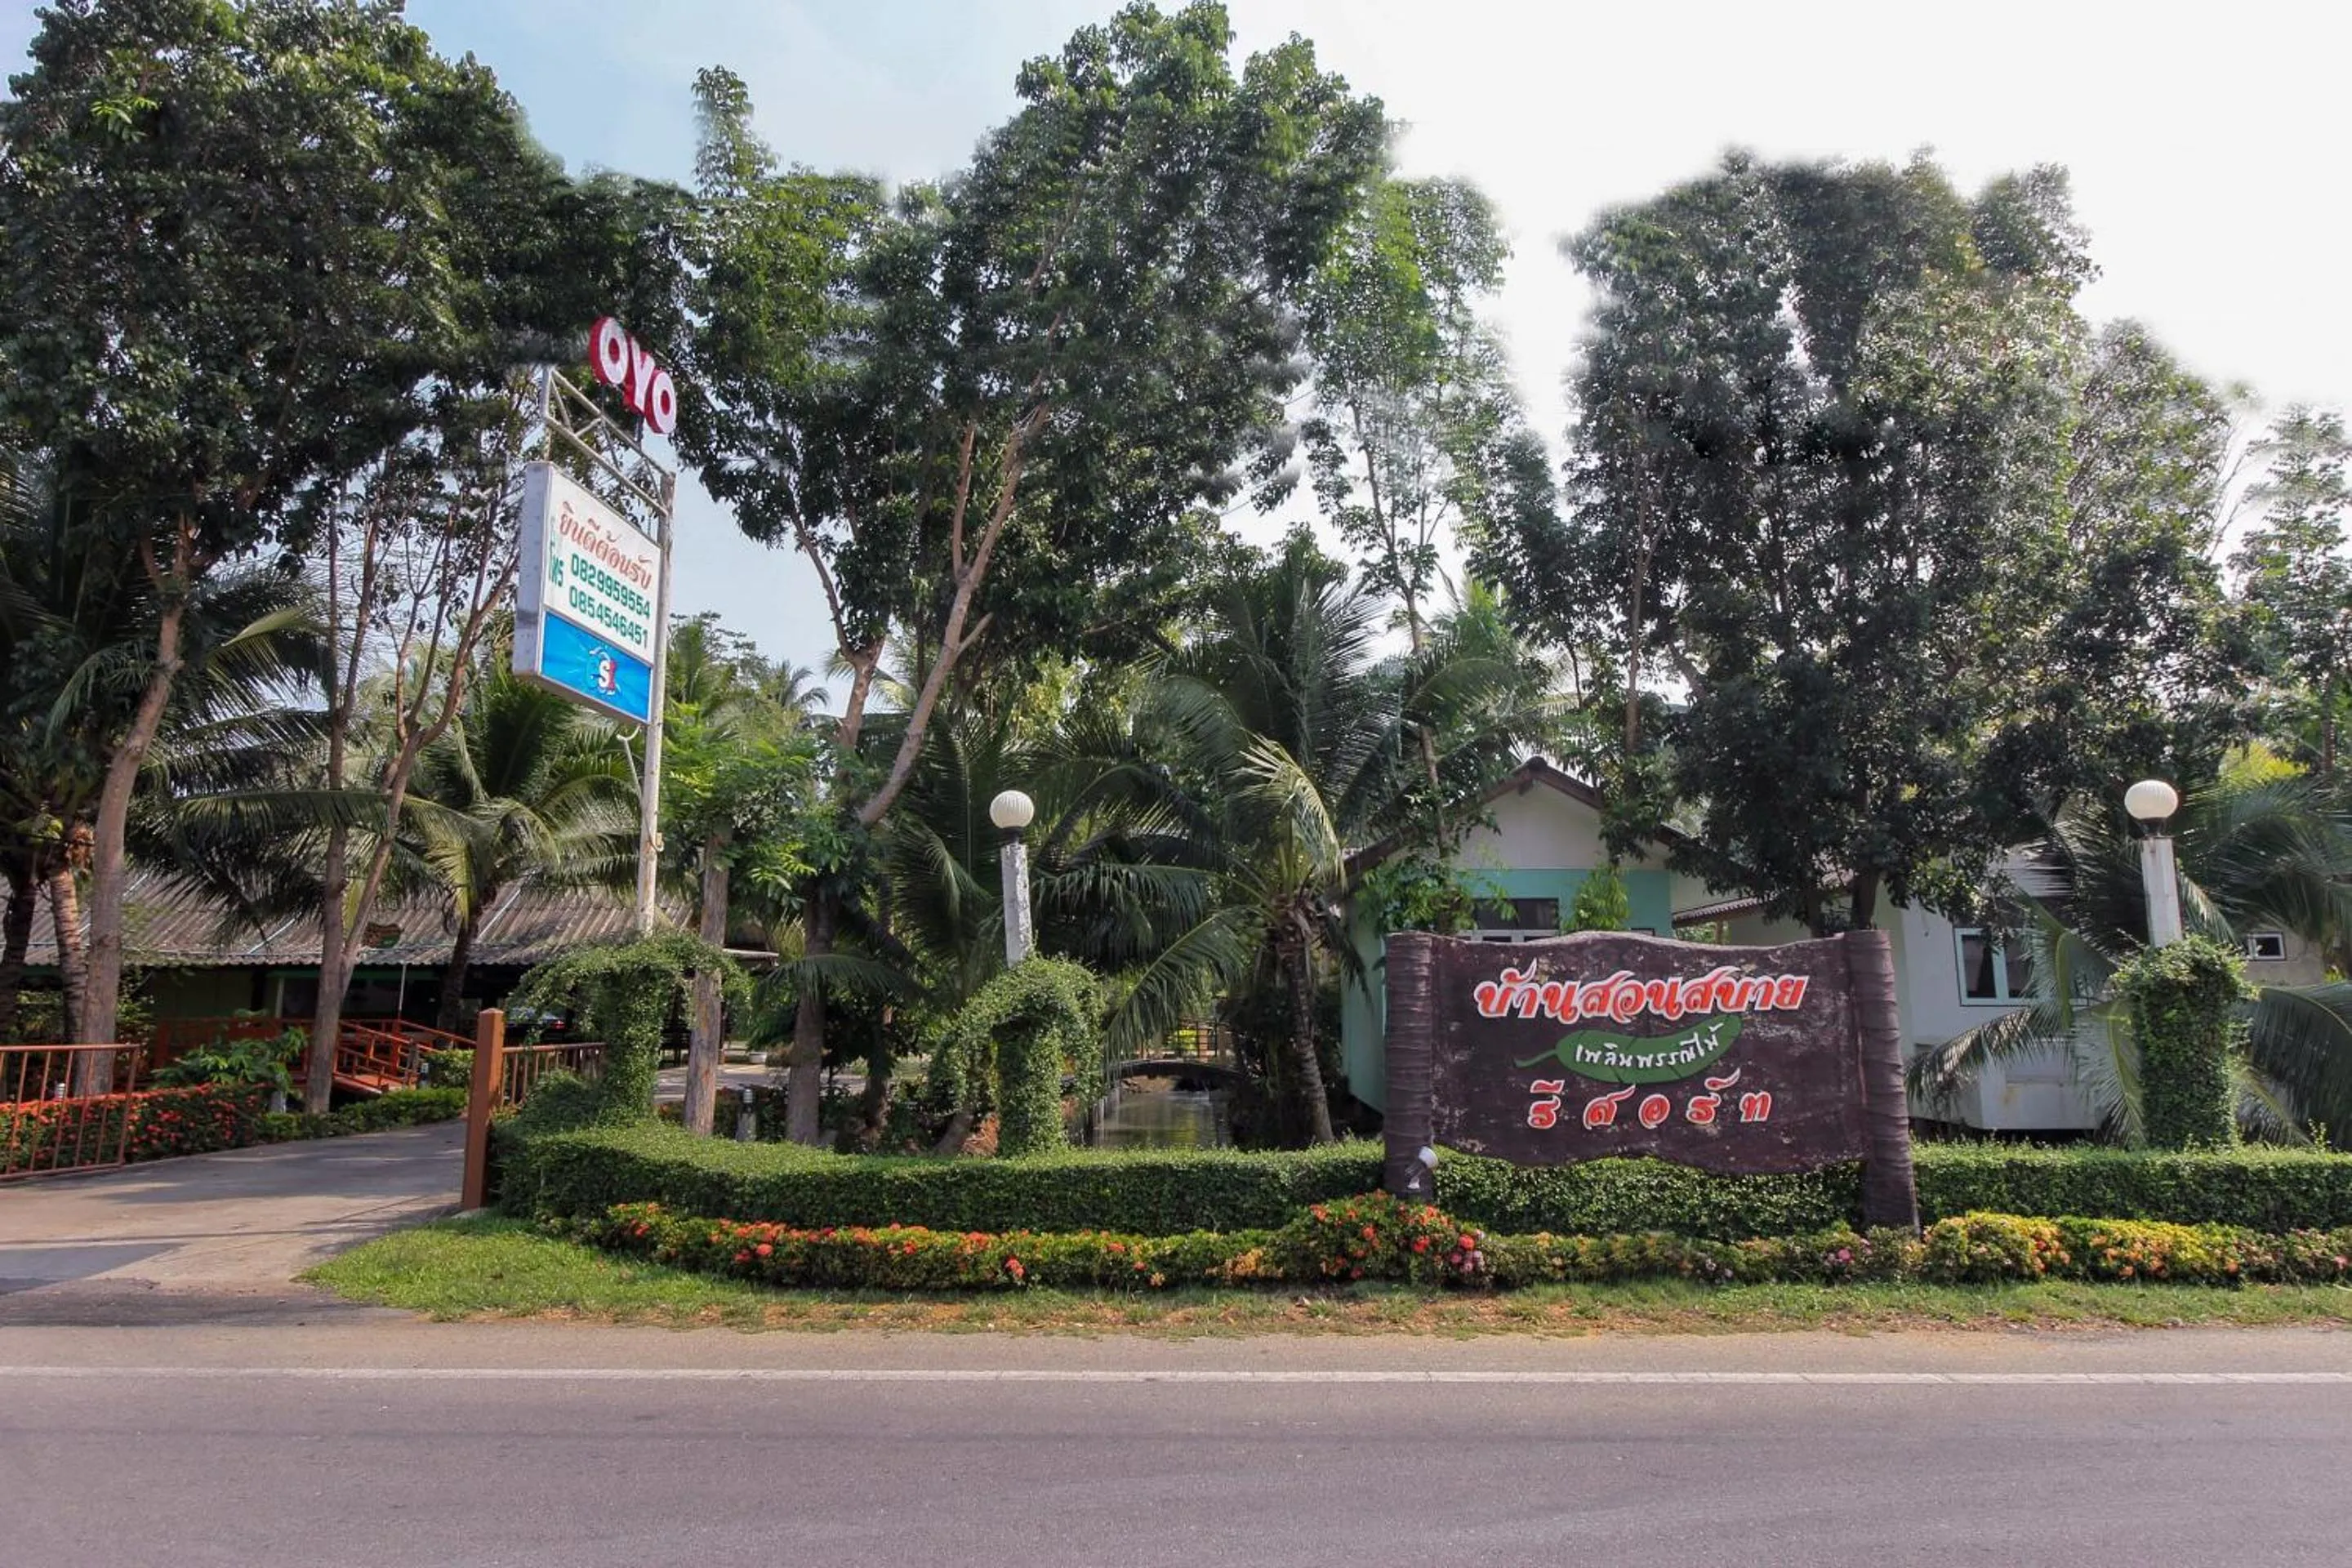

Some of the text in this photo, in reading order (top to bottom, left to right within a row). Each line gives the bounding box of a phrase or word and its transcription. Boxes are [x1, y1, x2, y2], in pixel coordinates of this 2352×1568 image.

[590, 314, 677, 434] OYO
[559, 501, 653, 590] ยินดีต้อนรับ
[569, 585, 648, 648] 0854546451
[570, 553, 651, 619] 0829959554
[1474, 958, 1810, 1024] บ้านสวนสบาย
[1527, 1067, 1771, 1129] รีสอร์ท
